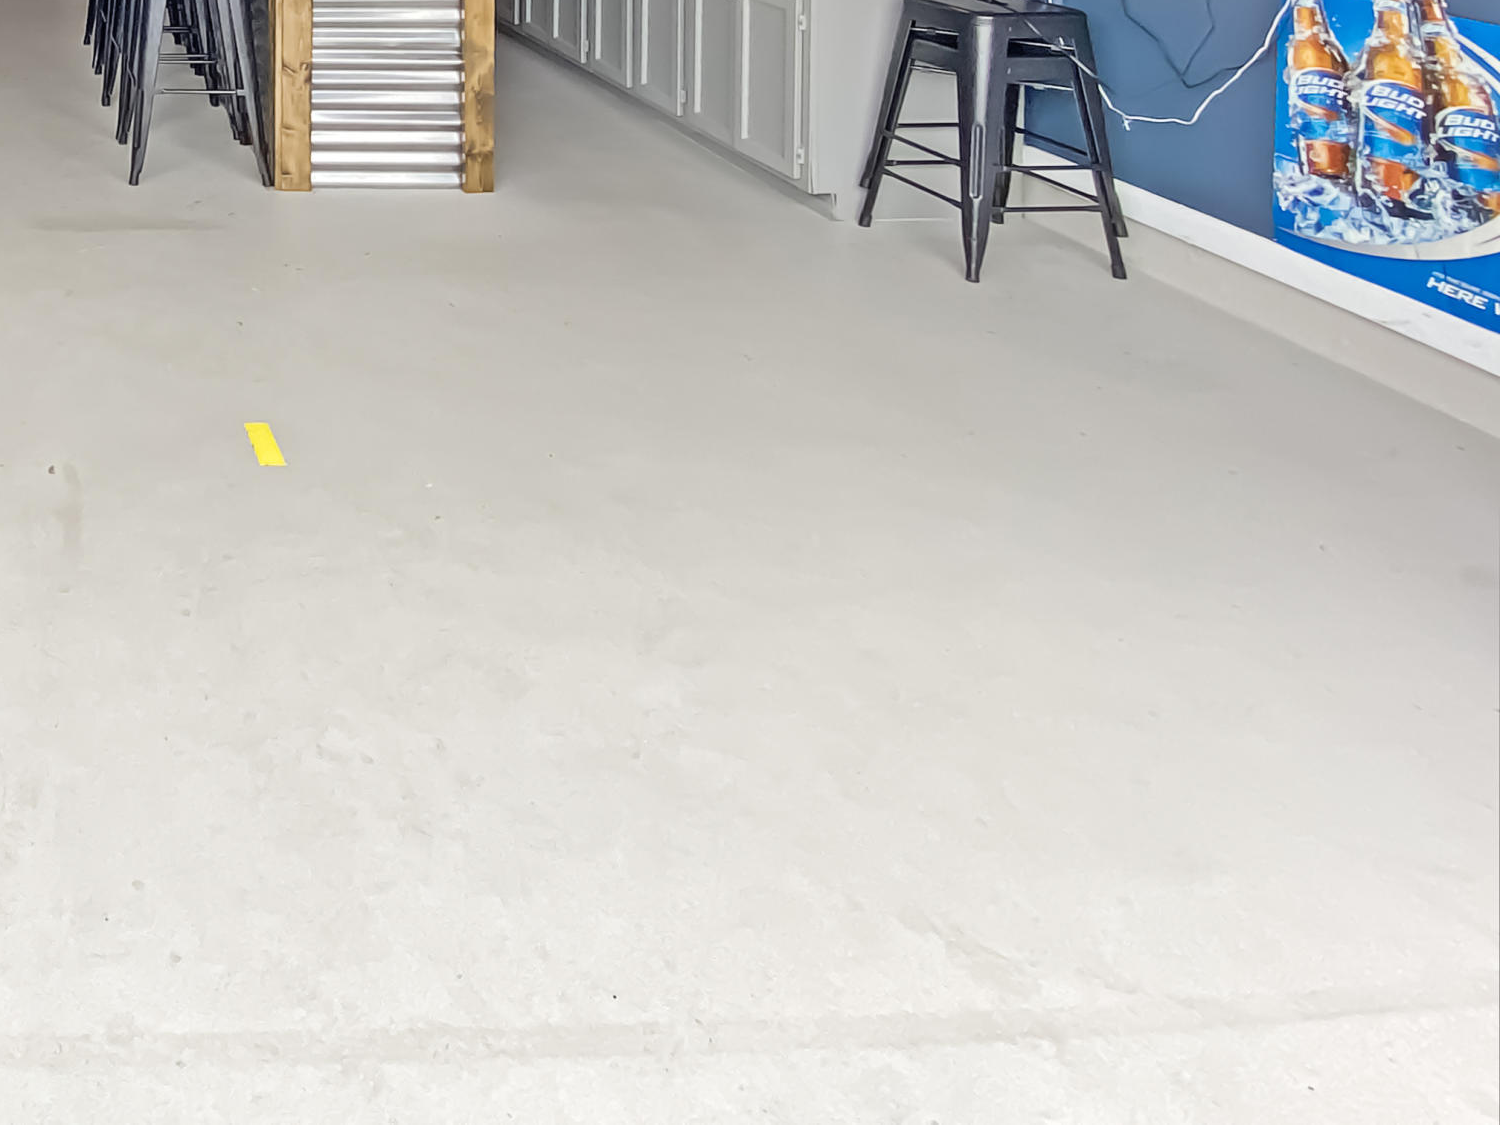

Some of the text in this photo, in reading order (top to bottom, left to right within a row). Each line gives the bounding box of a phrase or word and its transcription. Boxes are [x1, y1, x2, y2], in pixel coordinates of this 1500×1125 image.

[1297, 75, 1345, 90] BUD
[1371, 84, 1425, 109] BUD
[1365, 95, 1427, 120] LIGHT
[1443, 114, 1496, 131] BUD
[1438, 125, 1500, 143] LIGHT
[1426, 276, 1489, 311] HERE
